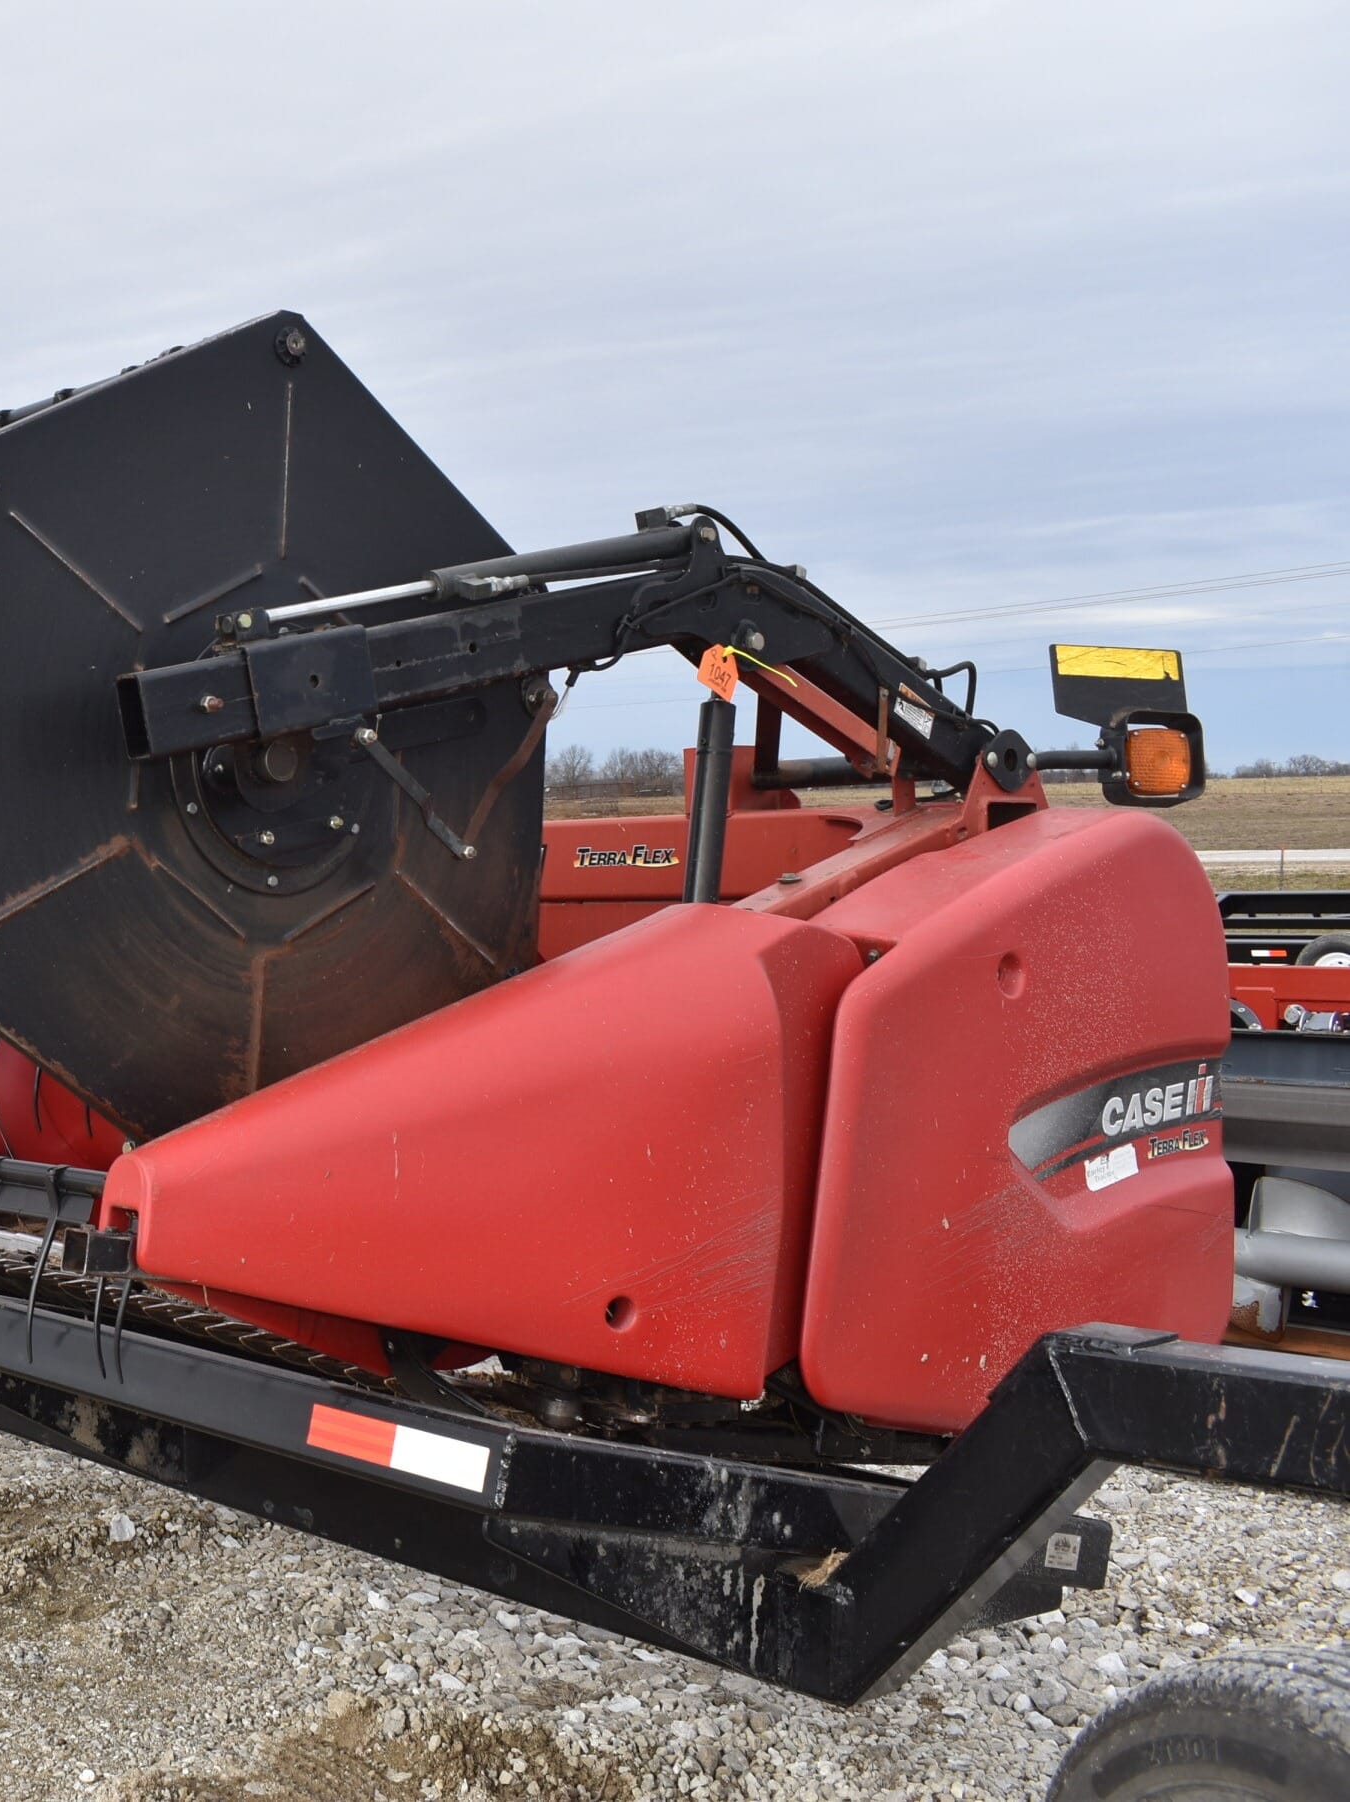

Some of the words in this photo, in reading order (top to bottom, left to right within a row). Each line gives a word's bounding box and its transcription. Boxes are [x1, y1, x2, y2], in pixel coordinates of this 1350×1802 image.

[710, 664, 732, 688] 1047
[577, 847, 627, 867] TERRA
[631, 845, 675, 865] FLEX
[1101, 1082, 1184, 1137] CASE
[1149, 1136, 1180, 1158] TERRA
[1182, 1129, 1206, 1149] FLEX
